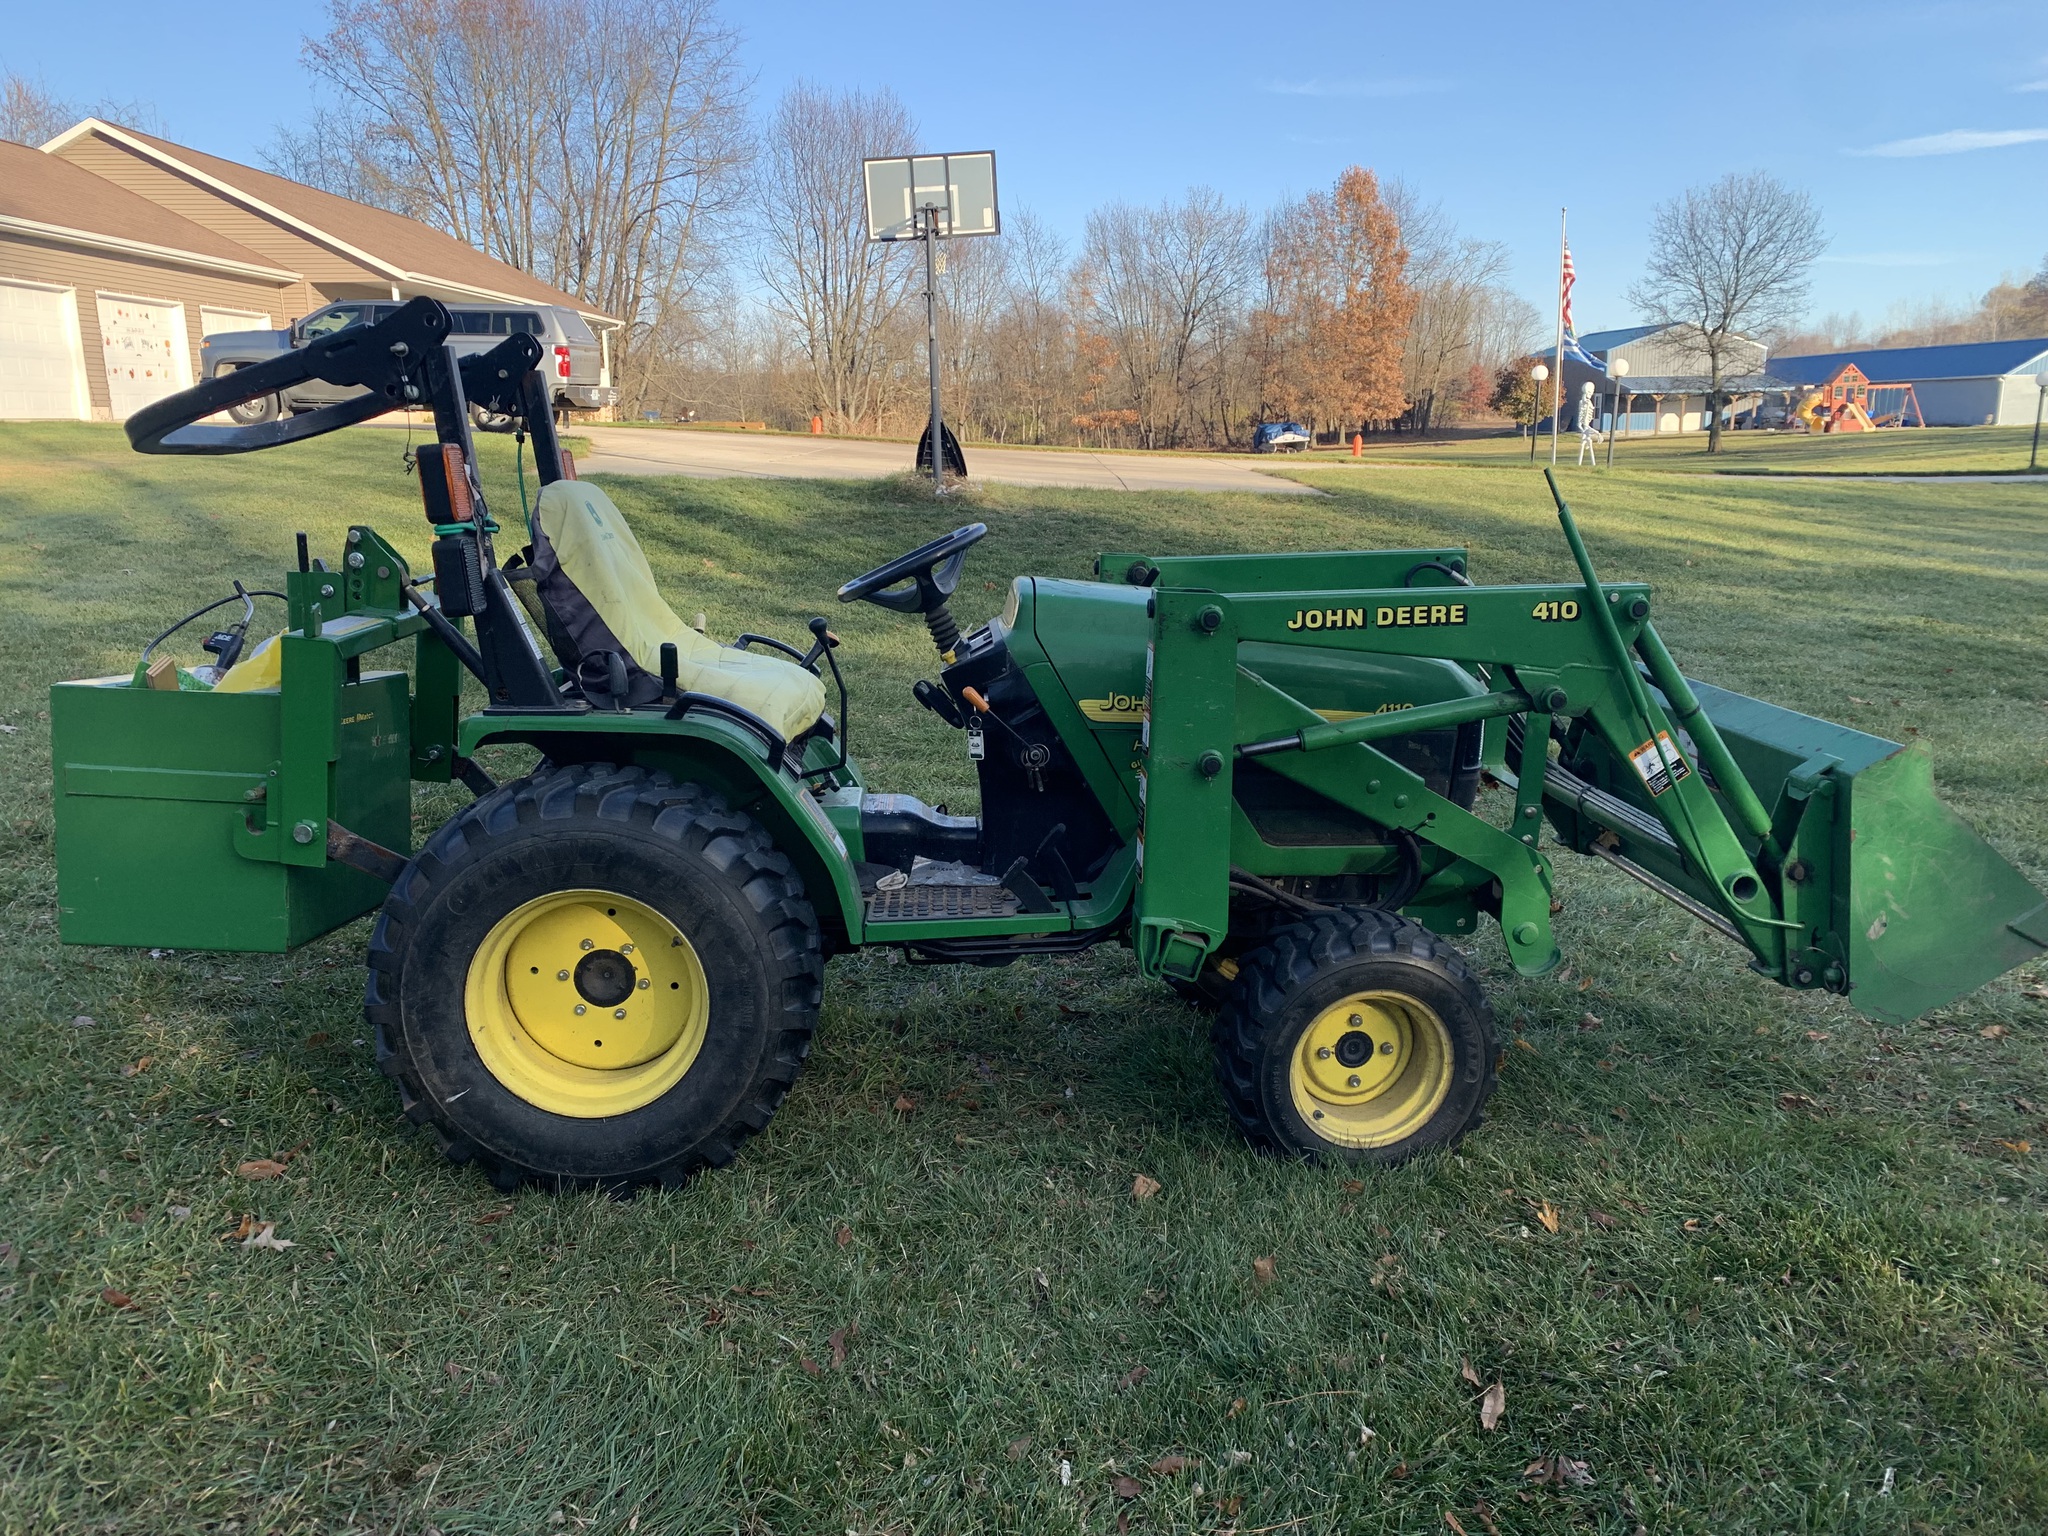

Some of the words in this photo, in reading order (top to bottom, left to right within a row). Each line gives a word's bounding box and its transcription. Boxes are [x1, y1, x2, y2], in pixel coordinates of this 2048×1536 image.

[1287, 608, 1365, 630] JOHN
[1376, 604, 1466, 626] DEERE
[1532, 601, 1579, 620] 410
[1100, 692, 1145, 710] JOH
